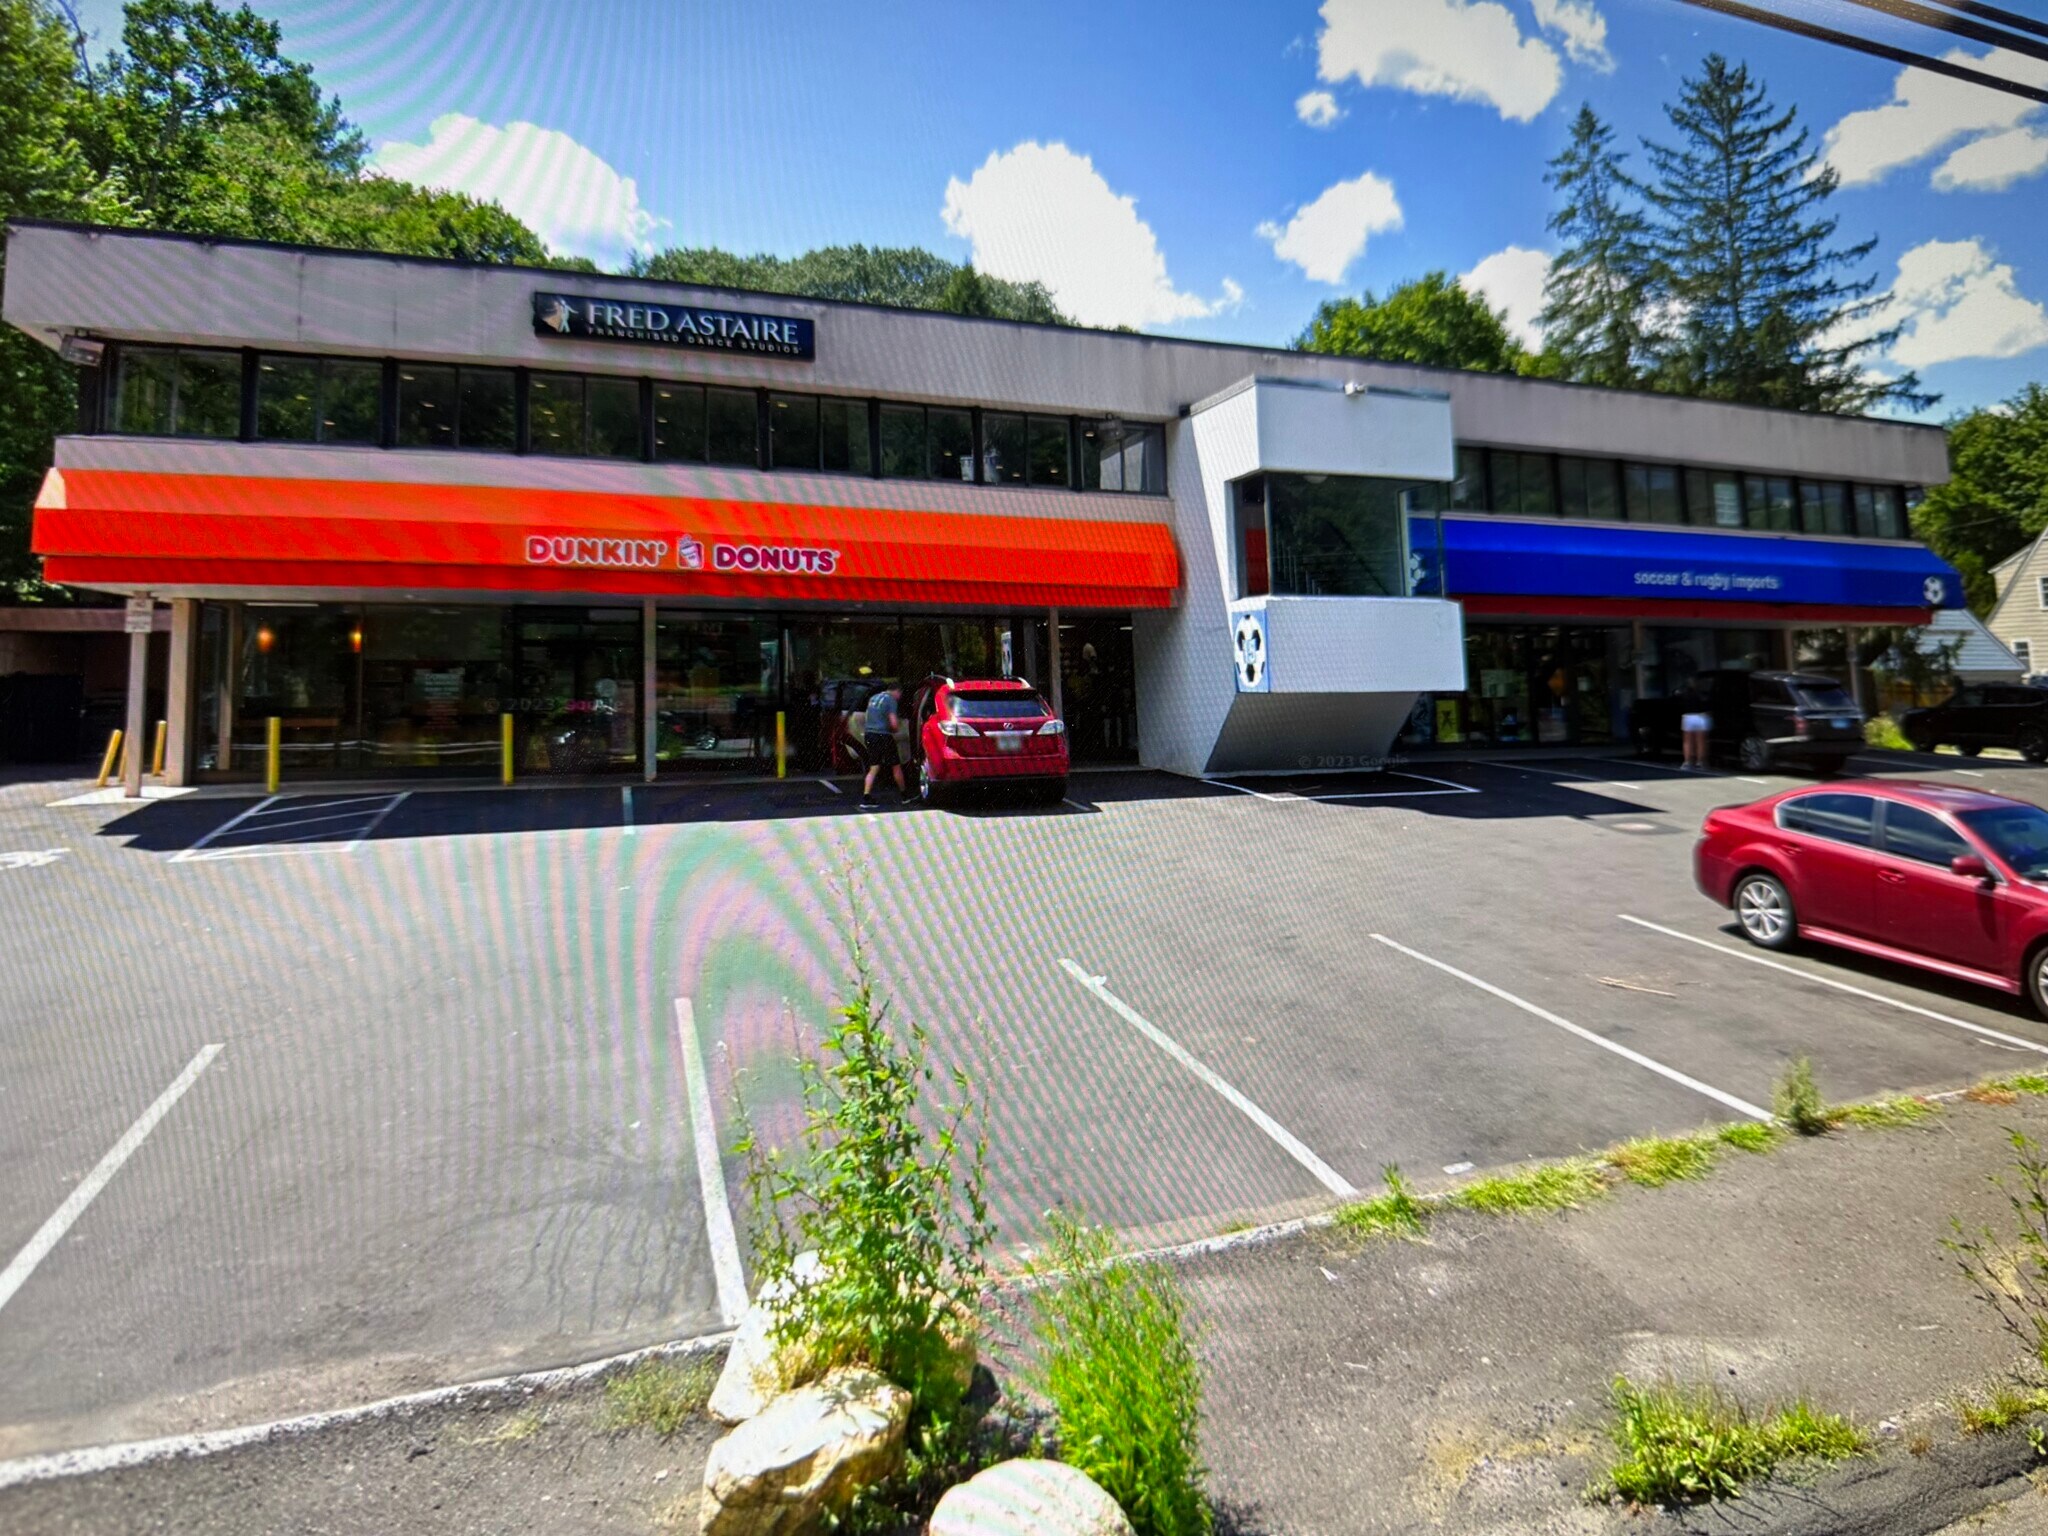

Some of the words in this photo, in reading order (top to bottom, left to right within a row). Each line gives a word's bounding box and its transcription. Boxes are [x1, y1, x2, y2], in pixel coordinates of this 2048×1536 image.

[587, 303, 671, 331] FRED
[676, 312, 800, 345] ASTAIRE
[587, 326, 680, 342] FRANCHISED
[688, 336, 733, 348] DANCE
[741, 341, 800, 354] STUDIOS
[526, 535, 668, 568] DUNKIN'
[712, 542, 837, 575] DONUTS
[1633, 571, 1679, 585] soccer
[1681, 572, 1693, 587] &
[1694, 573, 1730, 591] rugby
[1731, 574, 1780, 592] imports
